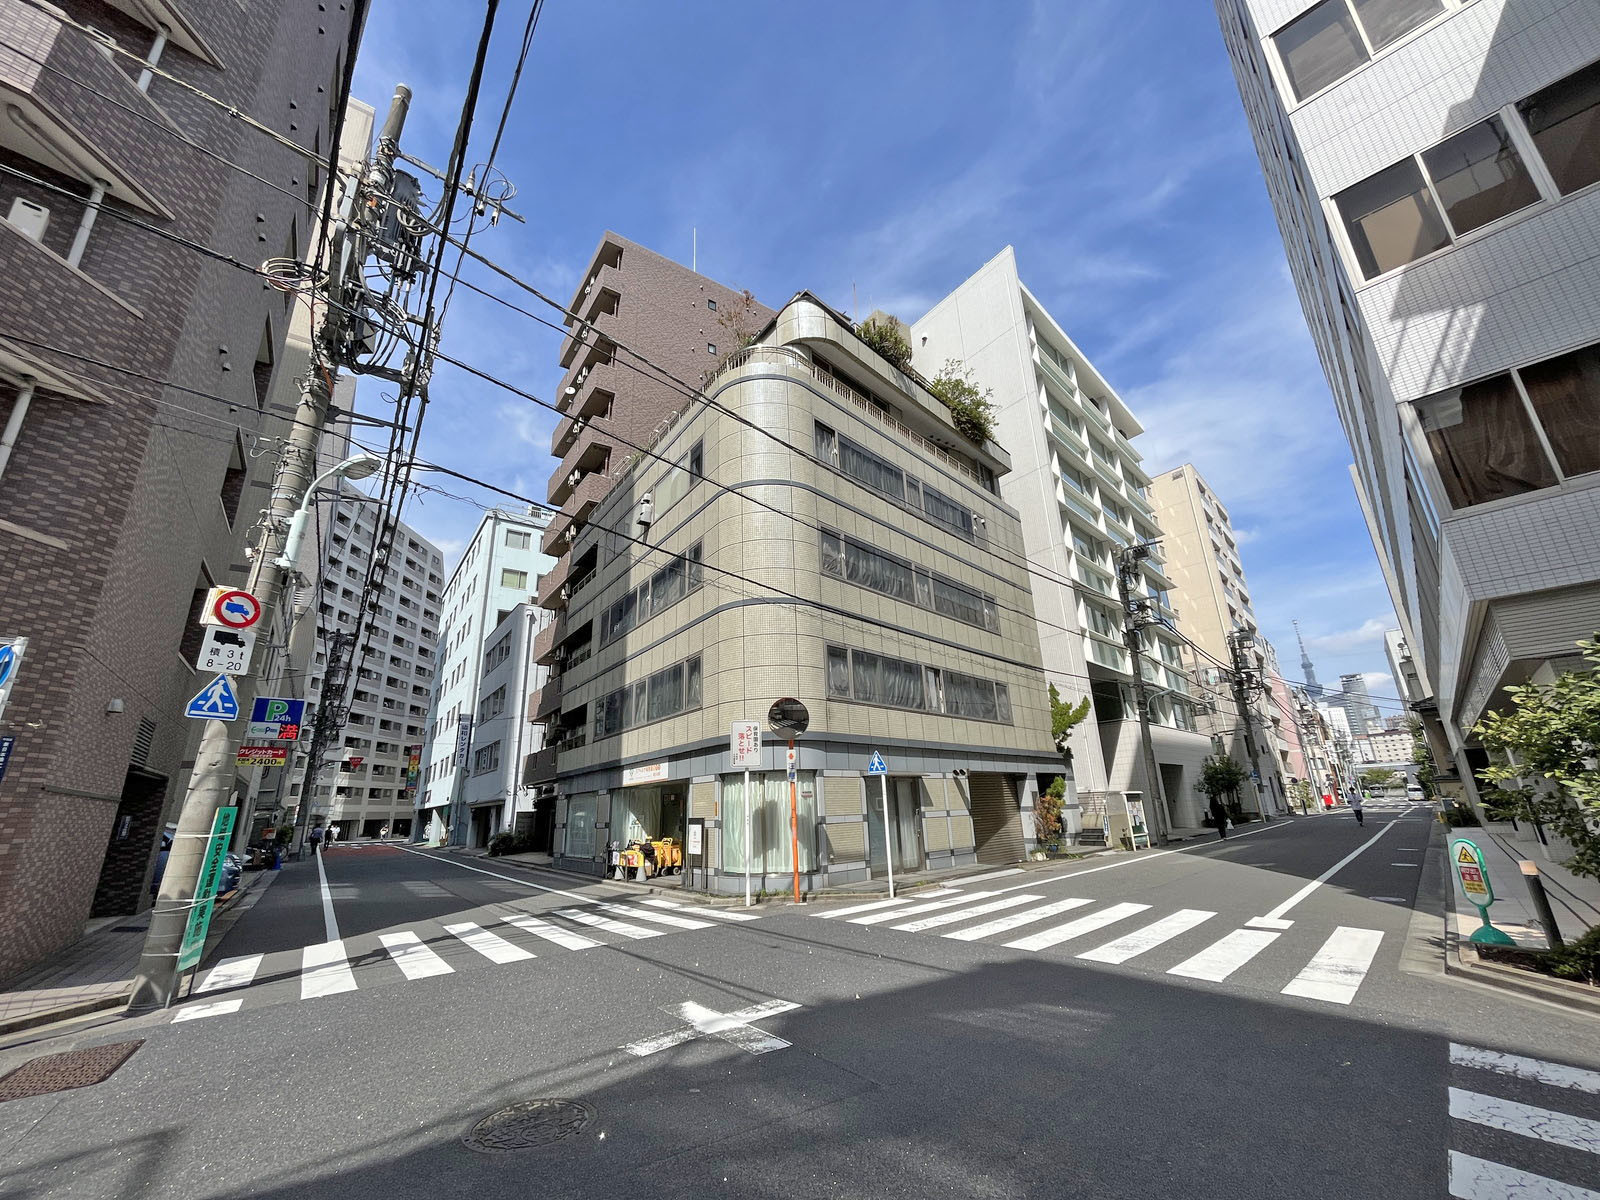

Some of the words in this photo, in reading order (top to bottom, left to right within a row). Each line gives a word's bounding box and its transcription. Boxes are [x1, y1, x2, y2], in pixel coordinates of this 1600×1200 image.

[209, 647, 221, 657] 積
[226, 649, 234, 659] 3
[239, 651, 245, 660] t
[265, 700, 289, 721] P
[273, 713, 292, 722] 24h
[278, 724, 299, 740] 満
[239, 748, 285, 756] クレジットカード
